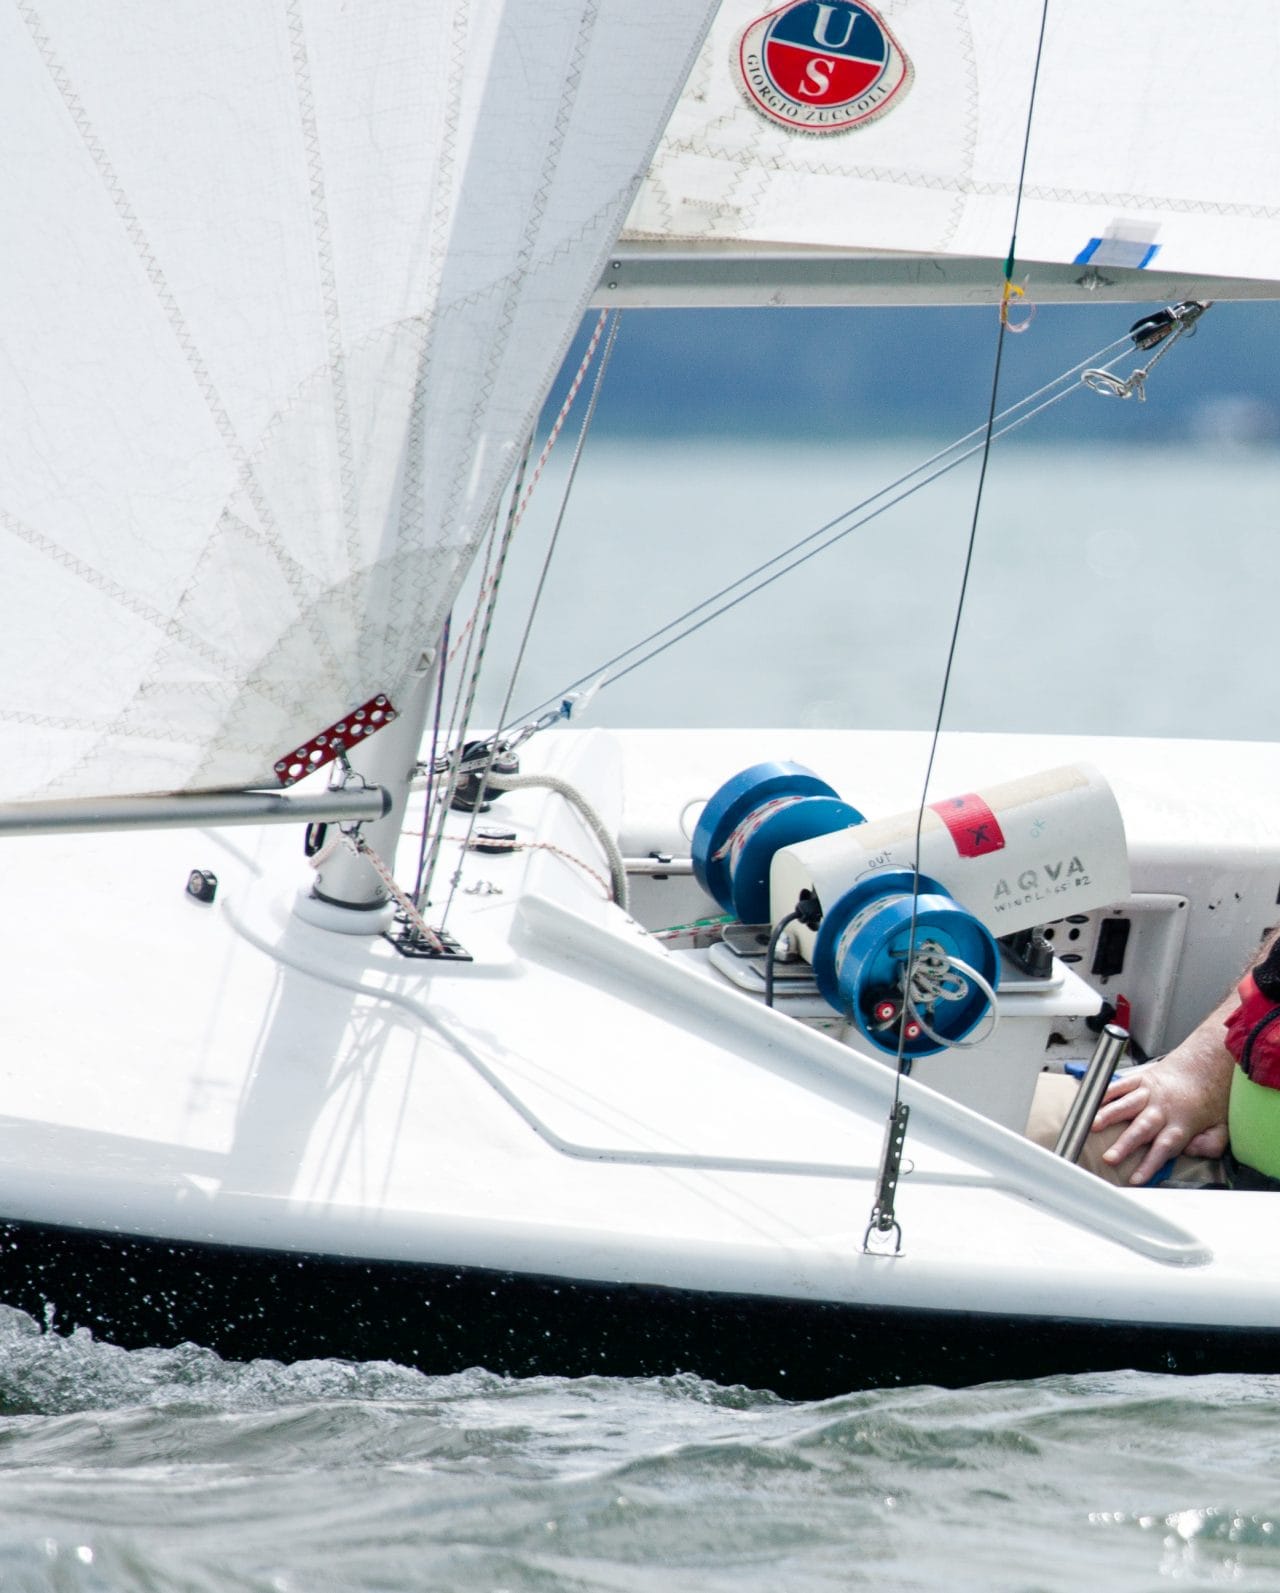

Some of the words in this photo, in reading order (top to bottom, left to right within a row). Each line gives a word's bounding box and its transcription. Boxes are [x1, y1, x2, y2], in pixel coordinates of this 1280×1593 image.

[812, 3, 862, 48] U
[747, 54, 799, 118] GIORGIO
[805, 86, 890, 122] ZUCCOLI
[797, 58, 836, 97] S
